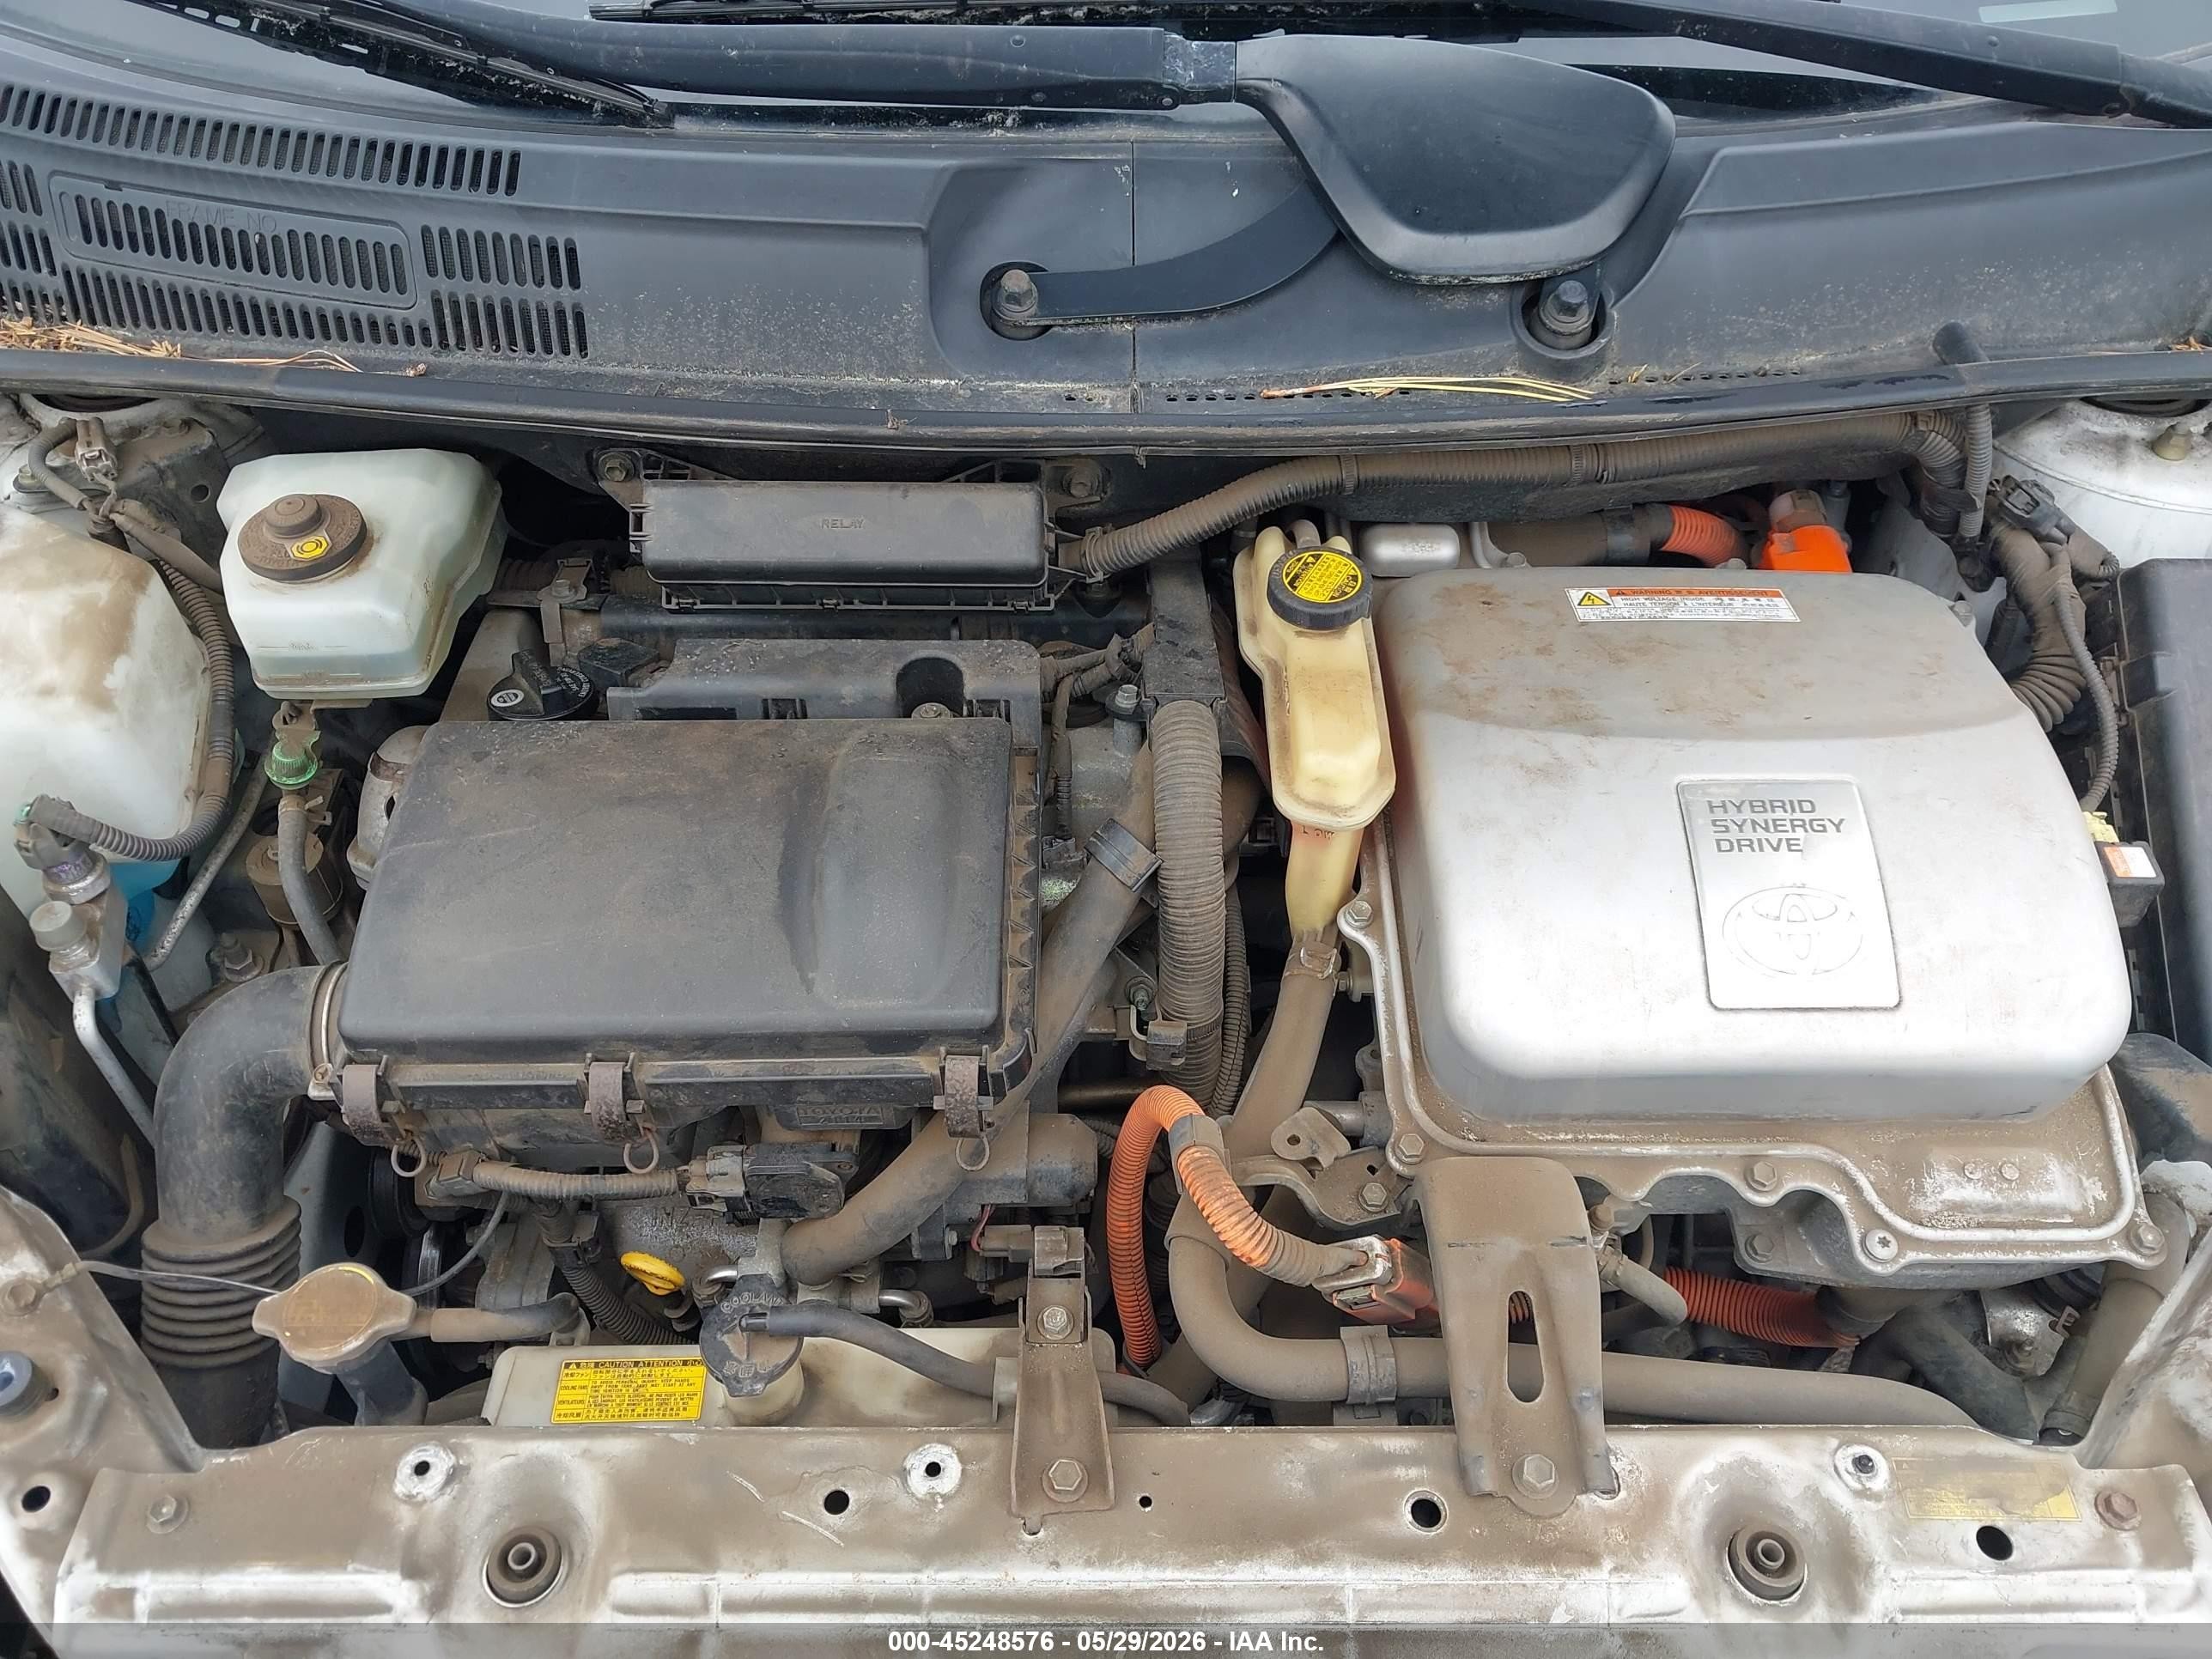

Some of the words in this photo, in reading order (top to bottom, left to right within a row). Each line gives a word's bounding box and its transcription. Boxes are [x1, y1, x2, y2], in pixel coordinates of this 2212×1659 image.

[820, 516, 865, 529] RELAY
[1706, 799, 1816, 815] HYBRID
[1710, 817, 1846, 834] SYNERGY
[1714, 837, 1804, 853] DRIVE
